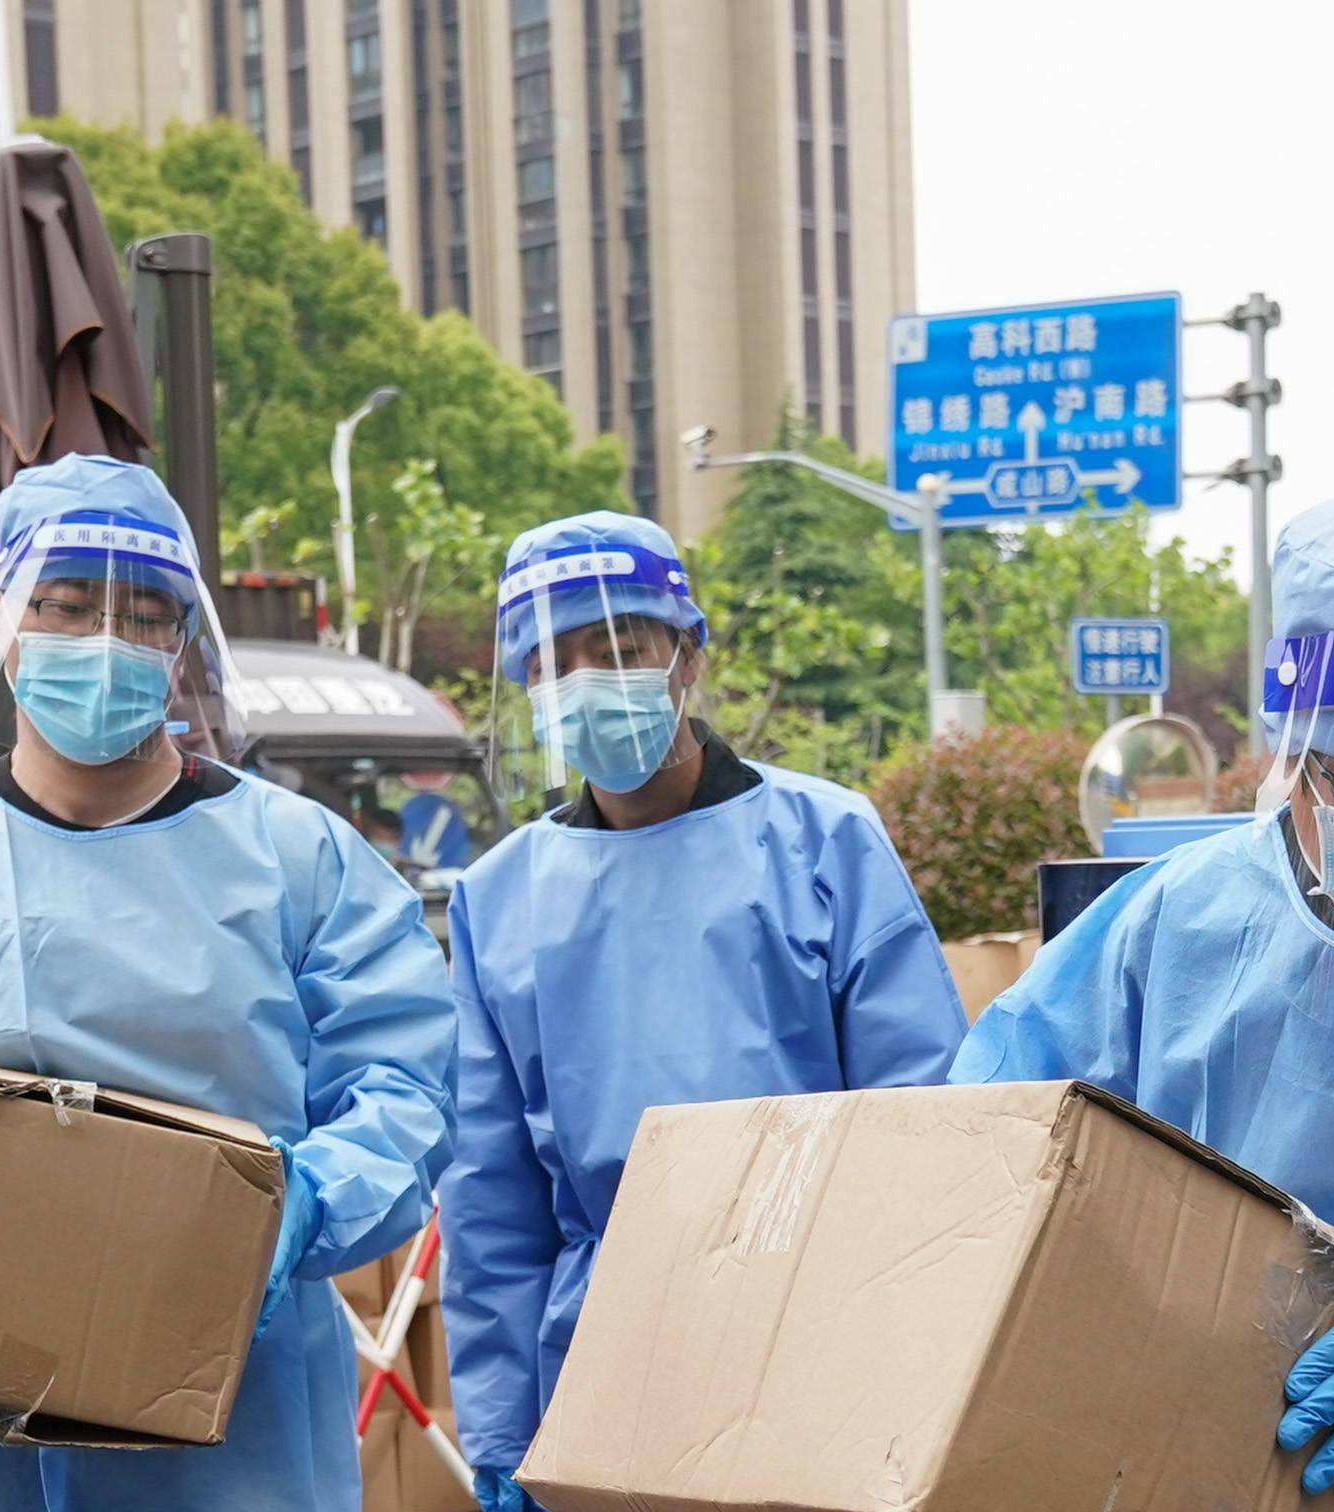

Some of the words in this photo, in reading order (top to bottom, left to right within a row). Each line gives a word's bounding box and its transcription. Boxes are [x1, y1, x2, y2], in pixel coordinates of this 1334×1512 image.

[969, 313, 1097, 360] 高科西路
[1053, 378, 1167, 424] 沪南路
[53, 529, 180, 557] 医用隔离面罩
